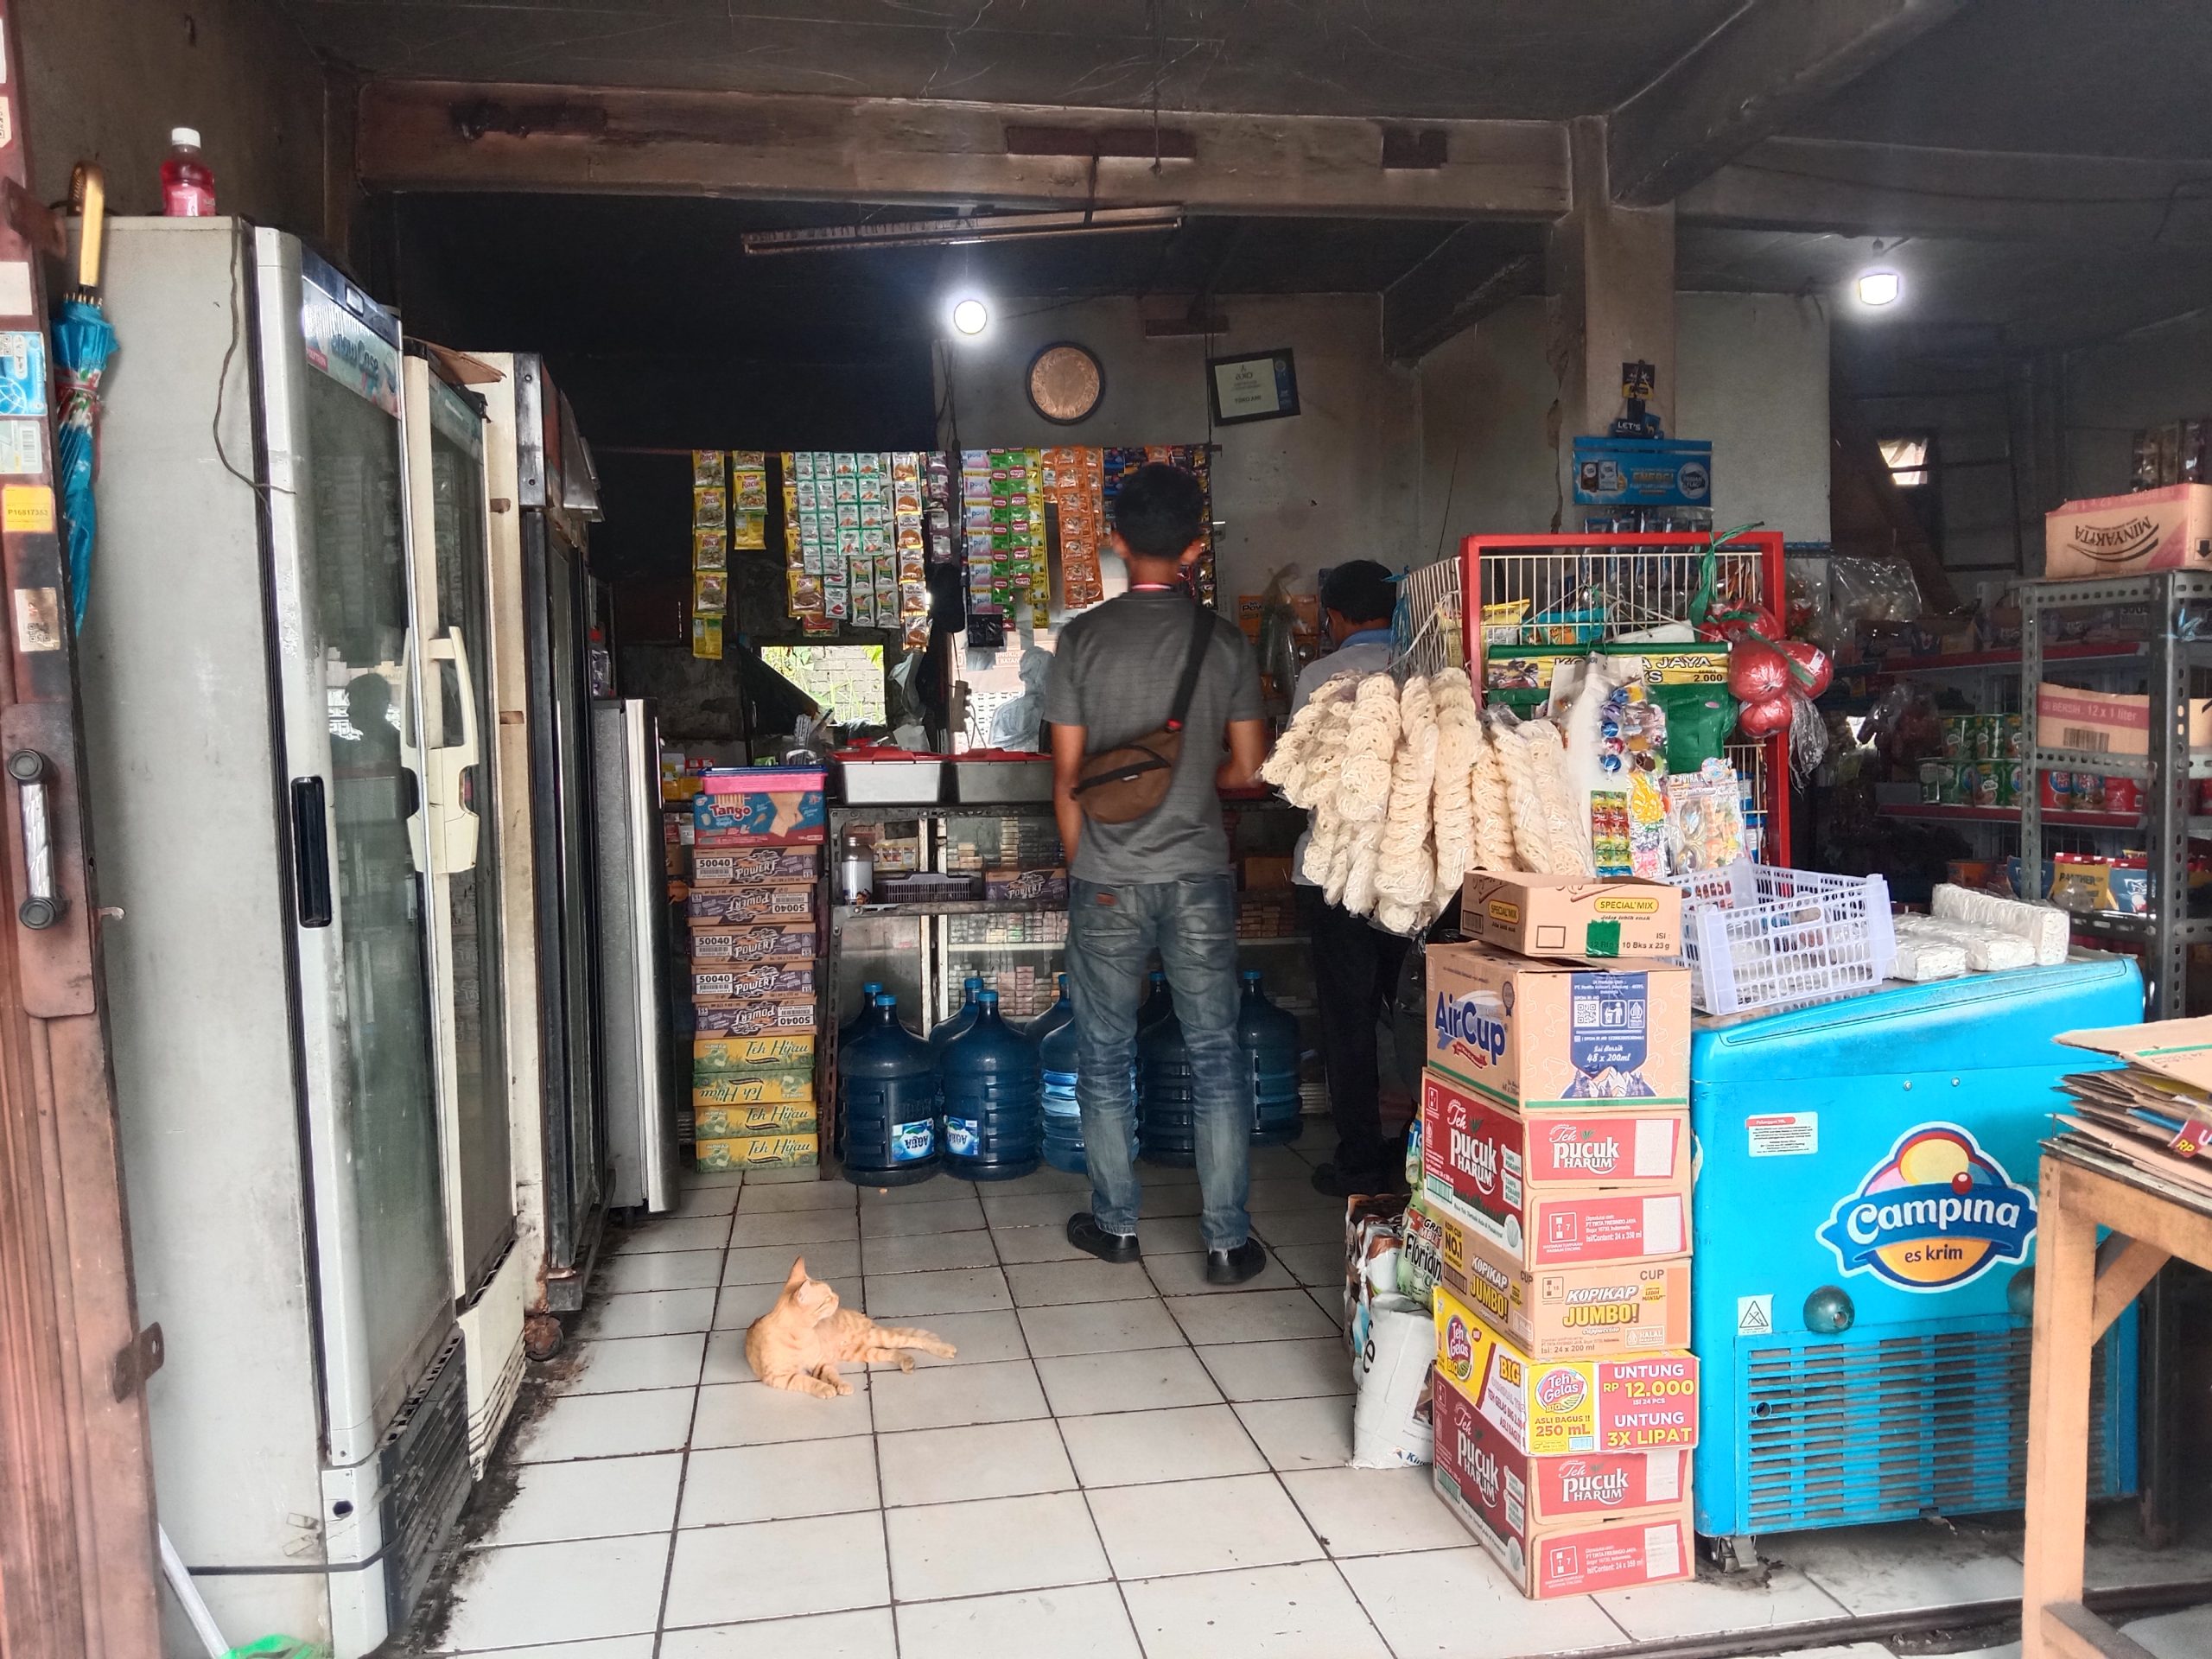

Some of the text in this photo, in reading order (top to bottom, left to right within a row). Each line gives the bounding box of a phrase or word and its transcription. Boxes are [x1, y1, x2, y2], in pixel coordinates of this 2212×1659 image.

[1618, 421, 1641, 431] LET'S
[1656, 657, 1711, 669] JAYA
[1694, 674, 1723, 683] 2.000
[2087, 704, 2099, 714] 12
[2117, 707, 2138, 721] liter
[709, 804, 753, 821] Tango
[699, 858, 731, 868] 50040
[773, 904, 805, 913] 50040
[699, 936, 730, 945] 50040
[699, 975, 730, 983] 50040
[780, 1016, 810, 1026] 50040
[1435, 991, 1505, 1065] AirCup
[746, 1039, 810, 1057] Teh Hijau
[1586, 1053, 1599, 1063] 48
[1606, 1053, 1631, 1062] 200ml
[699, 1086, 738, 1103] Hijau
[742, 1086, 764, 1102] Teh
[745, 1106, 766, 1122] Teh
[771, 1106, 810, 1122] Hijau
[1447, 1103, 1467, 1129] Teh
[905, 1135, 929, 1149] AQUA
[1549, 1126, 1577, 1142] Teh
[747, 1139, 769, 1154] Teh
[772, 1139, 812, 1154] Hijau
[1450, 1128, 1497, 1175] pucuk
[1553, 1136, 1620, 1169] pucuk
[2176, 1139, 2196, 1153] RP
[1564, 1156, 1615, 1169] HARUM
[1458, 1154, 1495, 1189] HARUM
[1846, 1196, 2021, 1244] Campina
[1615, 1231, 1621, 1240] 24
[1904, 1244, 1963, 1263] es krim
[1471, 1256, 1509, 1293] KOPIKAP
[1520, 1270, 1534, 1286] CUP
[1639, 1269, 1665, 1281] CUP
[1470, 1274, 1509, 1324] JUMBO!
[1565, 1285, 1639, 1305] KOPIKAP
[1563, 1303, 1640, 1328] JUMBO!
[1452, 1322, 1464, 1341] Teh
[1450, 1342, 1469, 1358] Gelas
[1498, 1355, 1522, 1388] BIG
[1613, 1363, 1685, 1379] UNTUNG
[1548, 1374, 1571, 1389] Teh
[1603, 1380, 1695, 1398] RP 12.000
[1543, 1382, 1580, 1403] Gelas
[1546, 1403, 1562, 1413] BIG
[1535, 1415, 1554, 1424] ASLI
[1555, 1415, 1580, 1424] BAGUS
[1614, 1411, 1685, 1427] UNTUNG
[1535, 1425, 1564, 1438] 250
[1607, 1427, 1693, 1447] 3X LIPAT
[1457, 1430, 1499, 1492] pucuk
[1558, 1461, 1586, 1478] Teh
[1464, 1461, 1497, 1503] HARUM
[1562, 1467, 1630, 1503] pucuk
[1573, 1489, 1624, 1502] HARUM
[1616, 1561, 1623, 1570] 24
